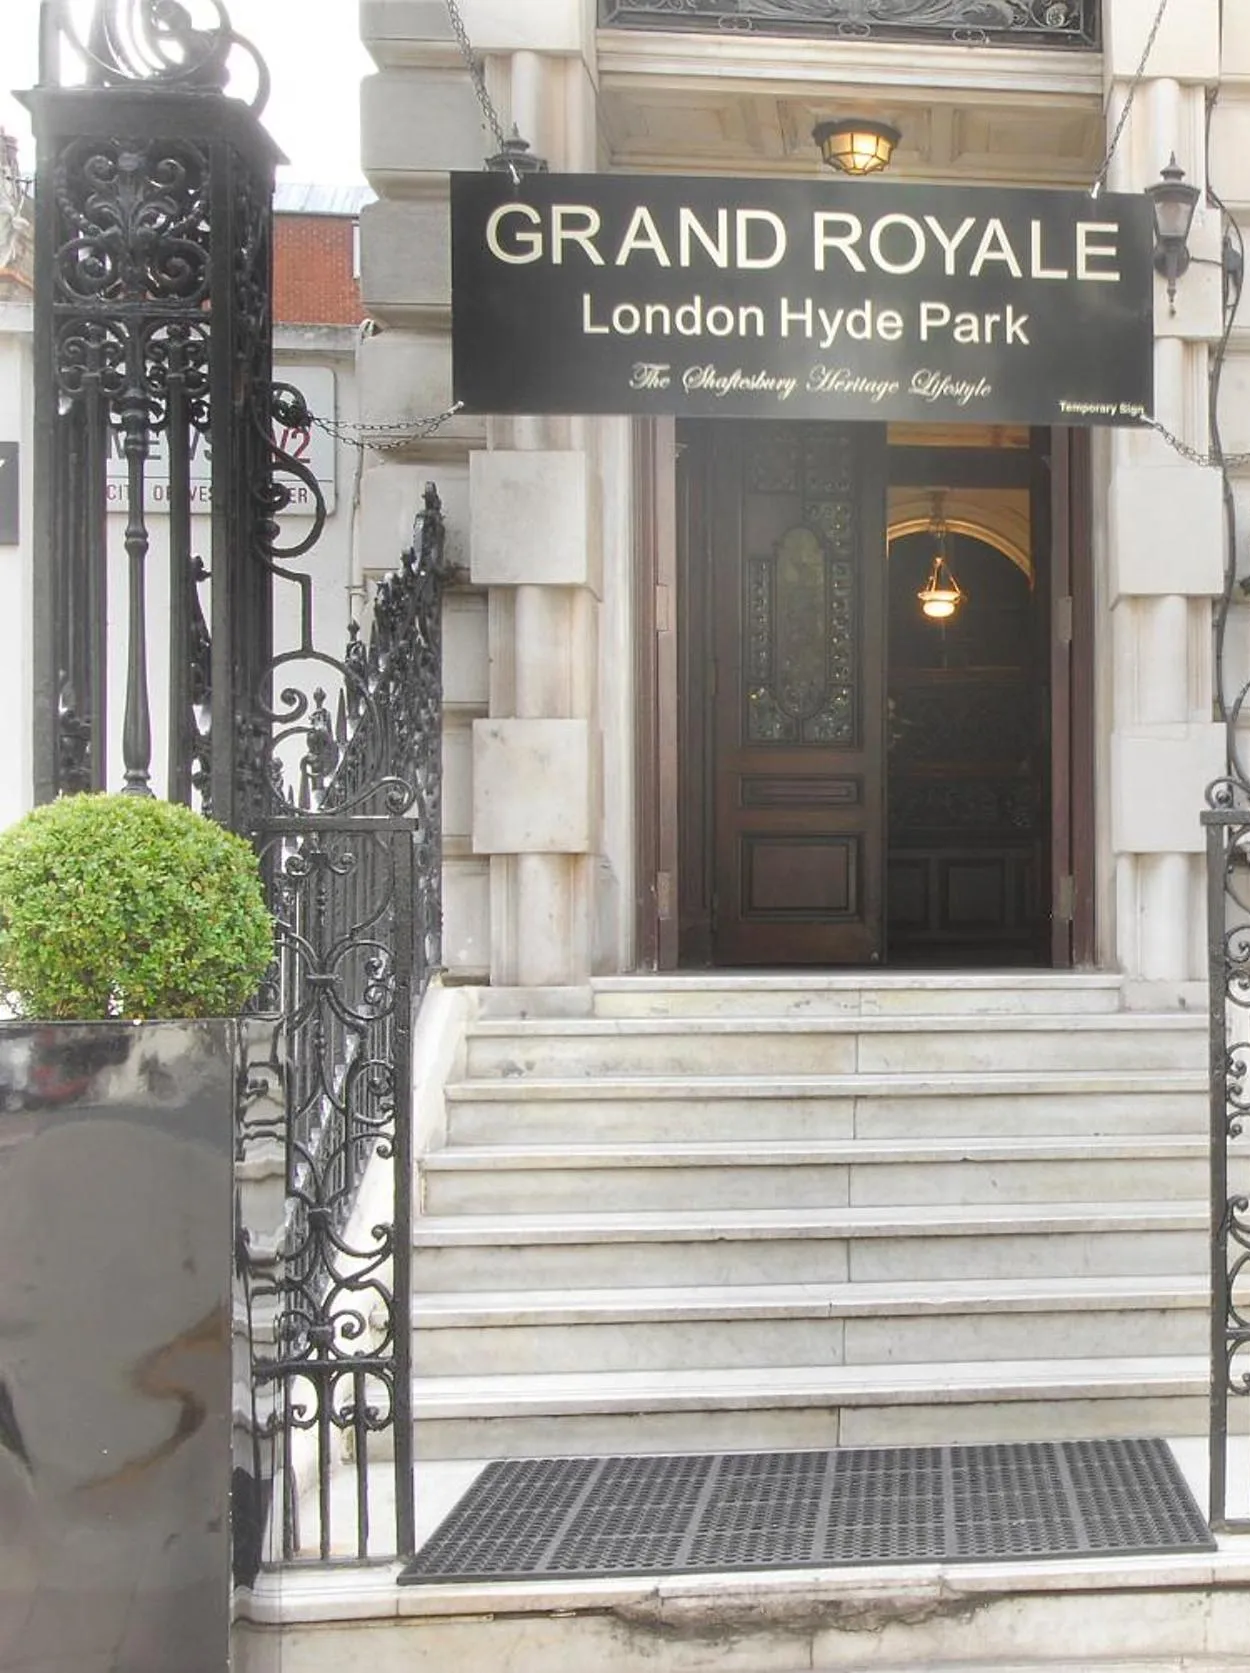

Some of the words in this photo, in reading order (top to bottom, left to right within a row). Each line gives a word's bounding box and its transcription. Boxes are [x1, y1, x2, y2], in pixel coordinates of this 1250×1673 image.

[485, 203, 788, 270] GRAND
[813, 210, 1121, 282] ROYALE
[582, 293, 764, 337] London
[780, 296, 904, 348] Hyde
[919, 300, 1030, 345] Park
[628, 362, 671, 390] The
[682, 364, 798, 401] Shaftesbury
[805, 364, 900, 402] Heritage
[908, 368, 992, 405] Lifestyle
[1060, 400, 1117, 417] Temporary
[1119, 402, 1145, 417] Sign
